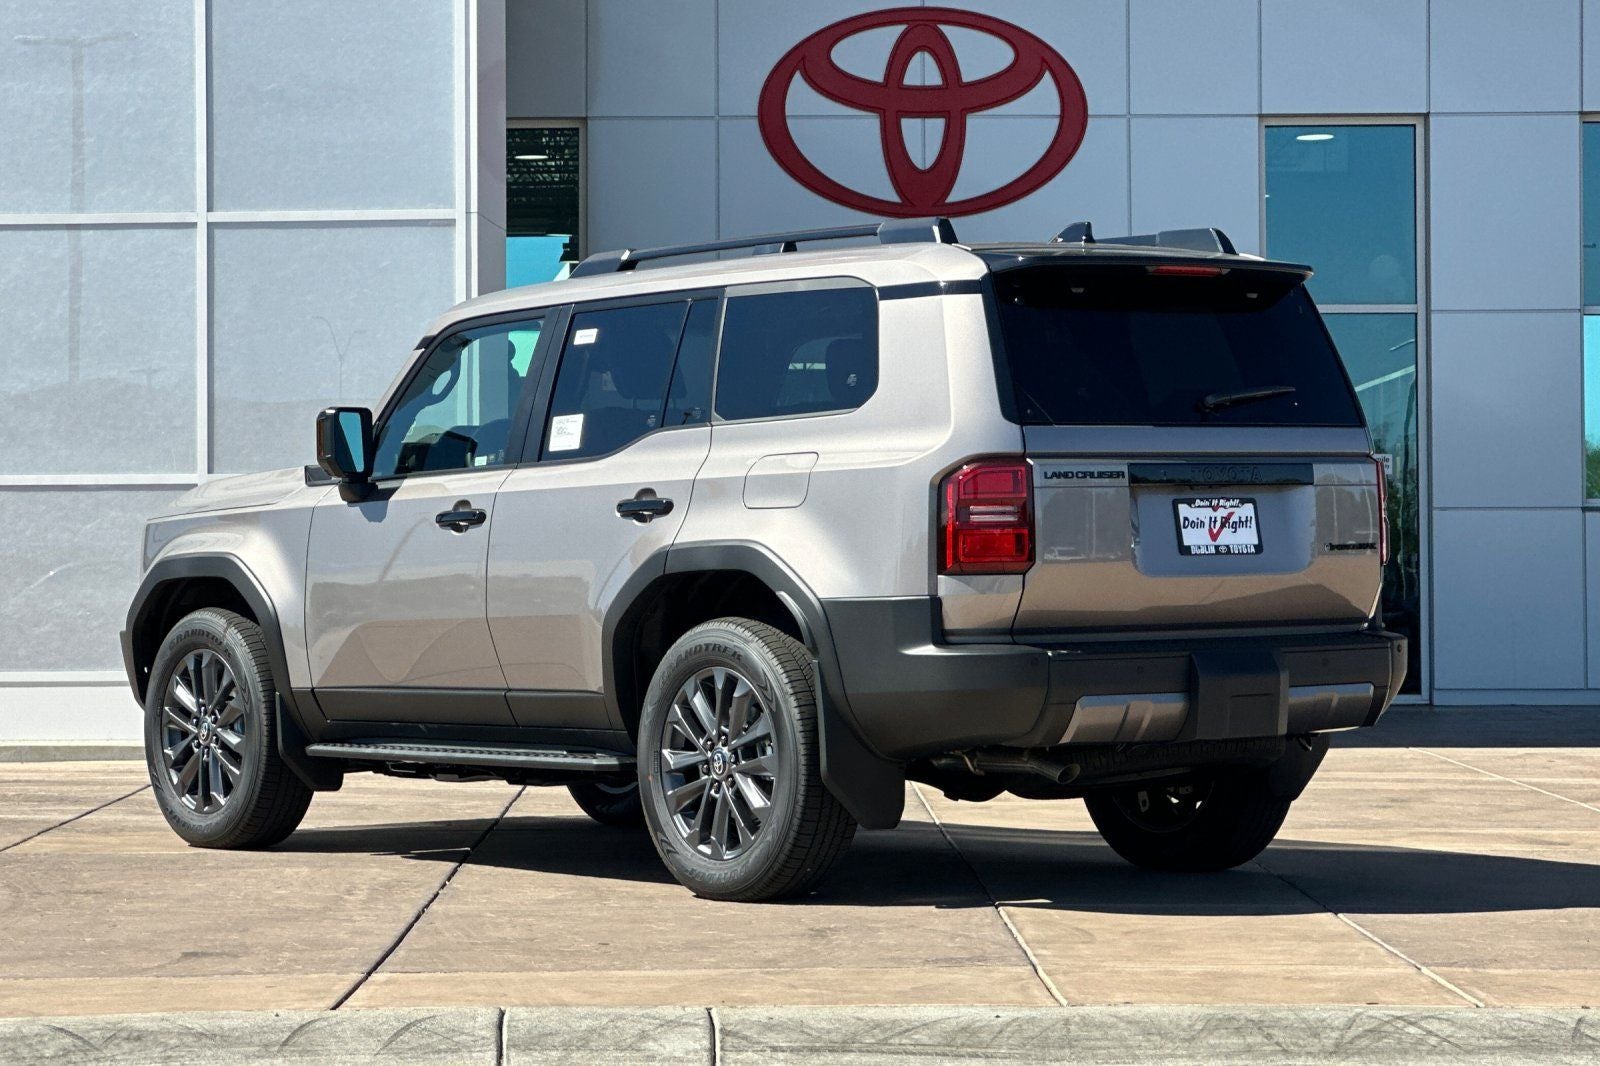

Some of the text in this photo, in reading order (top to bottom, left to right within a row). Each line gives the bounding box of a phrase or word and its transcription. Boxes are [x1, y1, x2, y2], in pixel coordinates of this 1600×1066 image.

[1043, 470, 1126, 479] LAND CRUISER
[1191, 465, 1264, 481] TOYOTA
[1182, 516, 1253, 533] Doin' It Right!
[1229, 545, 1256, 554] TOYOTA
